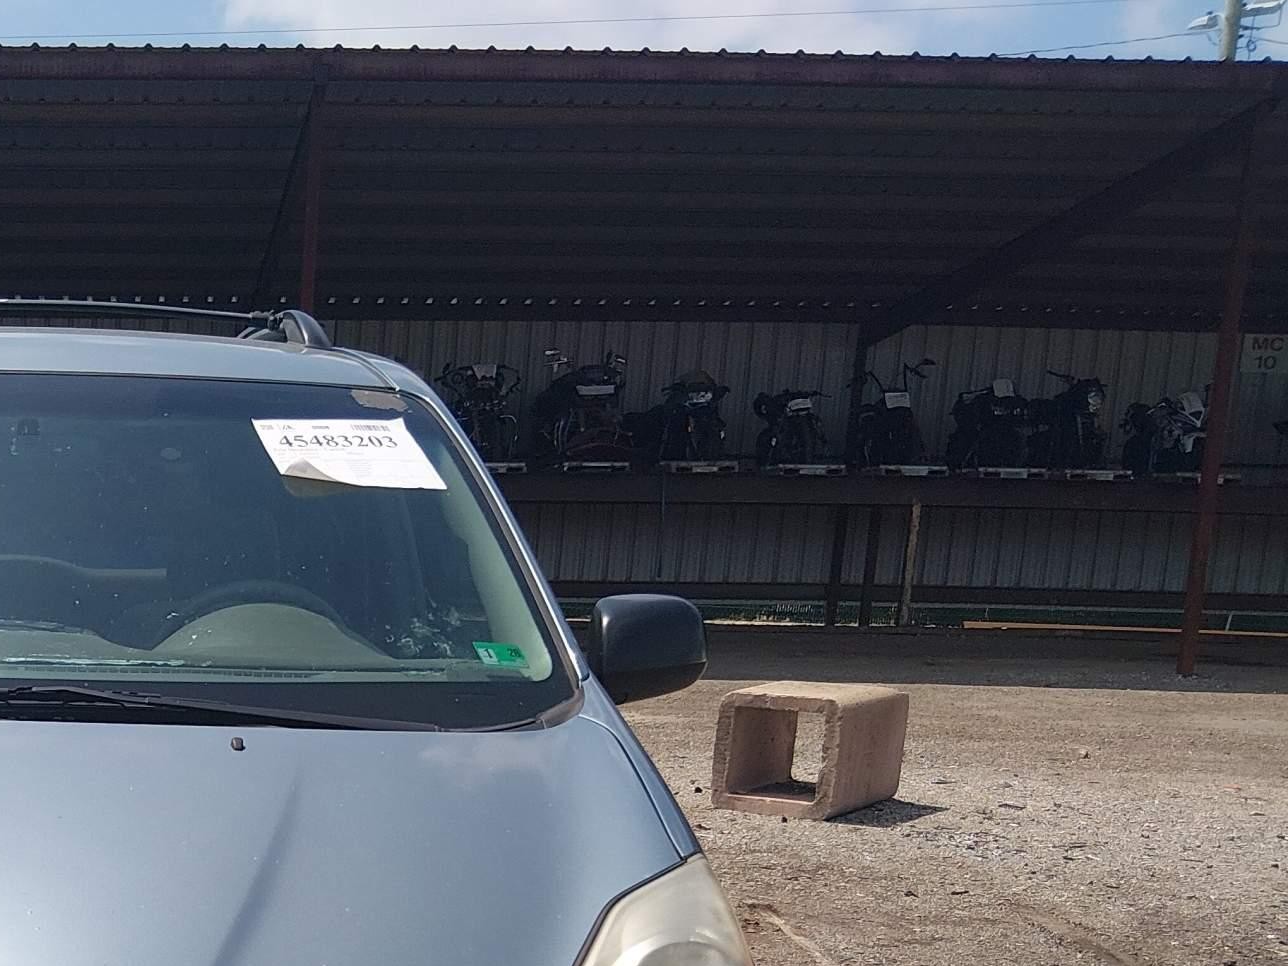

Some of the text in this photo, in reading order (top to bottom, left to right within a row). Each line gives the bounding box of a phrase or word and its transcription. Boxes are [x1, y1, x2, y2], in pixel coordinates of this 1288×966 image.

[1252, 337, 1284, 351] MC
[1255, 356, 1277, 369] 10
[279, 434, 399, 448] 45483203
